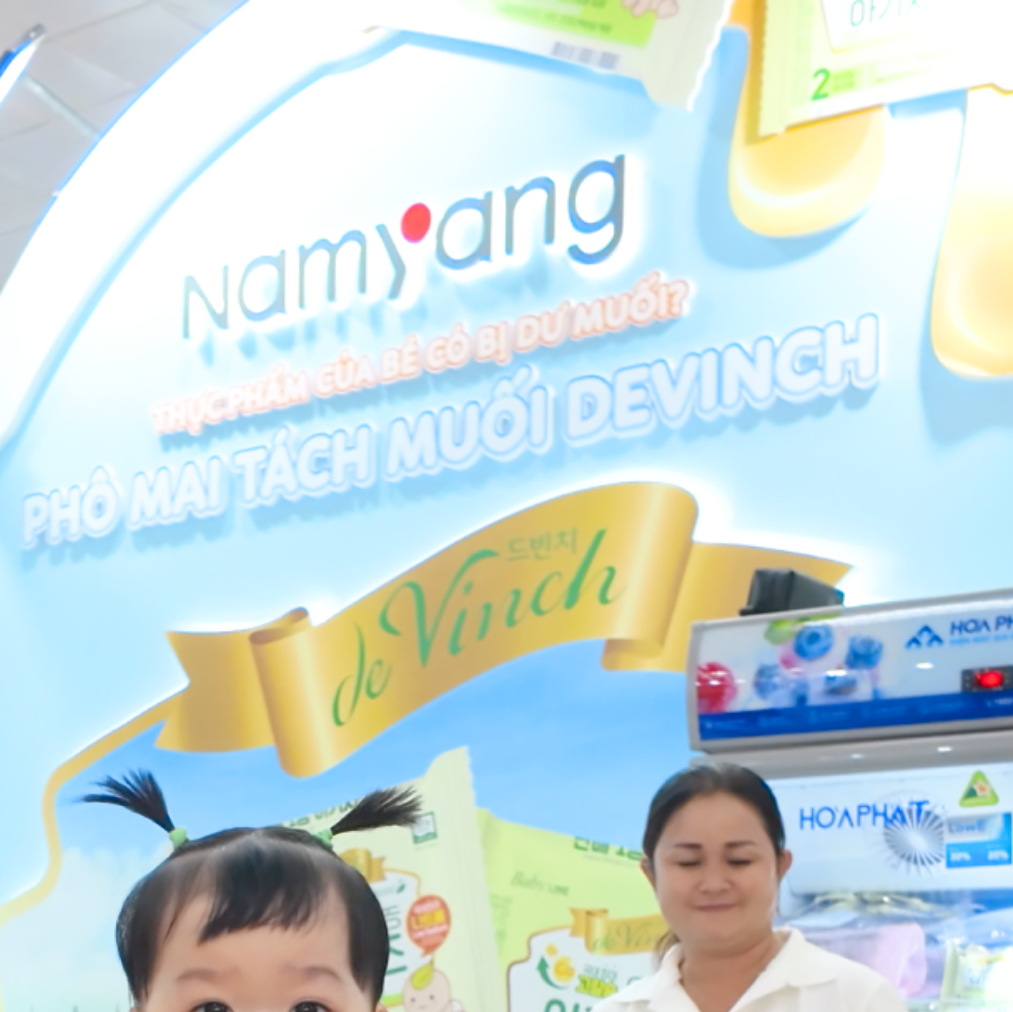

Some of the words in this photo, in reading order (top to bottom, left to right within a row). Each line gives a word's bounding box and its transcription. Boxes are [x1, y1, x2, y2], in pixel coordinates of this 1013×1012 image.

[811, 68, 831, 101] 2
[182, 154, 625, 339] Namyang
[313, 349, 378, 398] CỦA
[380, 333, 421, 384] BÉ
[422, 321, 470, 373] CÓ
[472, 320, 512, 365] BỊ
[513, 300, 572, 353] DƯ
[571, 270, 690, 340] MUỐI?
[21, 465, 118, 549] PHÔ
[126, 456, 230, 530] MAI
[233, 425, 376, 508] TÁCH
[384, 363, 552, 481] MUỐI
[562, 313, 881, 444] DEVINCH
[504, 527, 579, 562] 드빈치
[332, 620, 393, 727] de
[378, 528, 628, 669] Vinch
